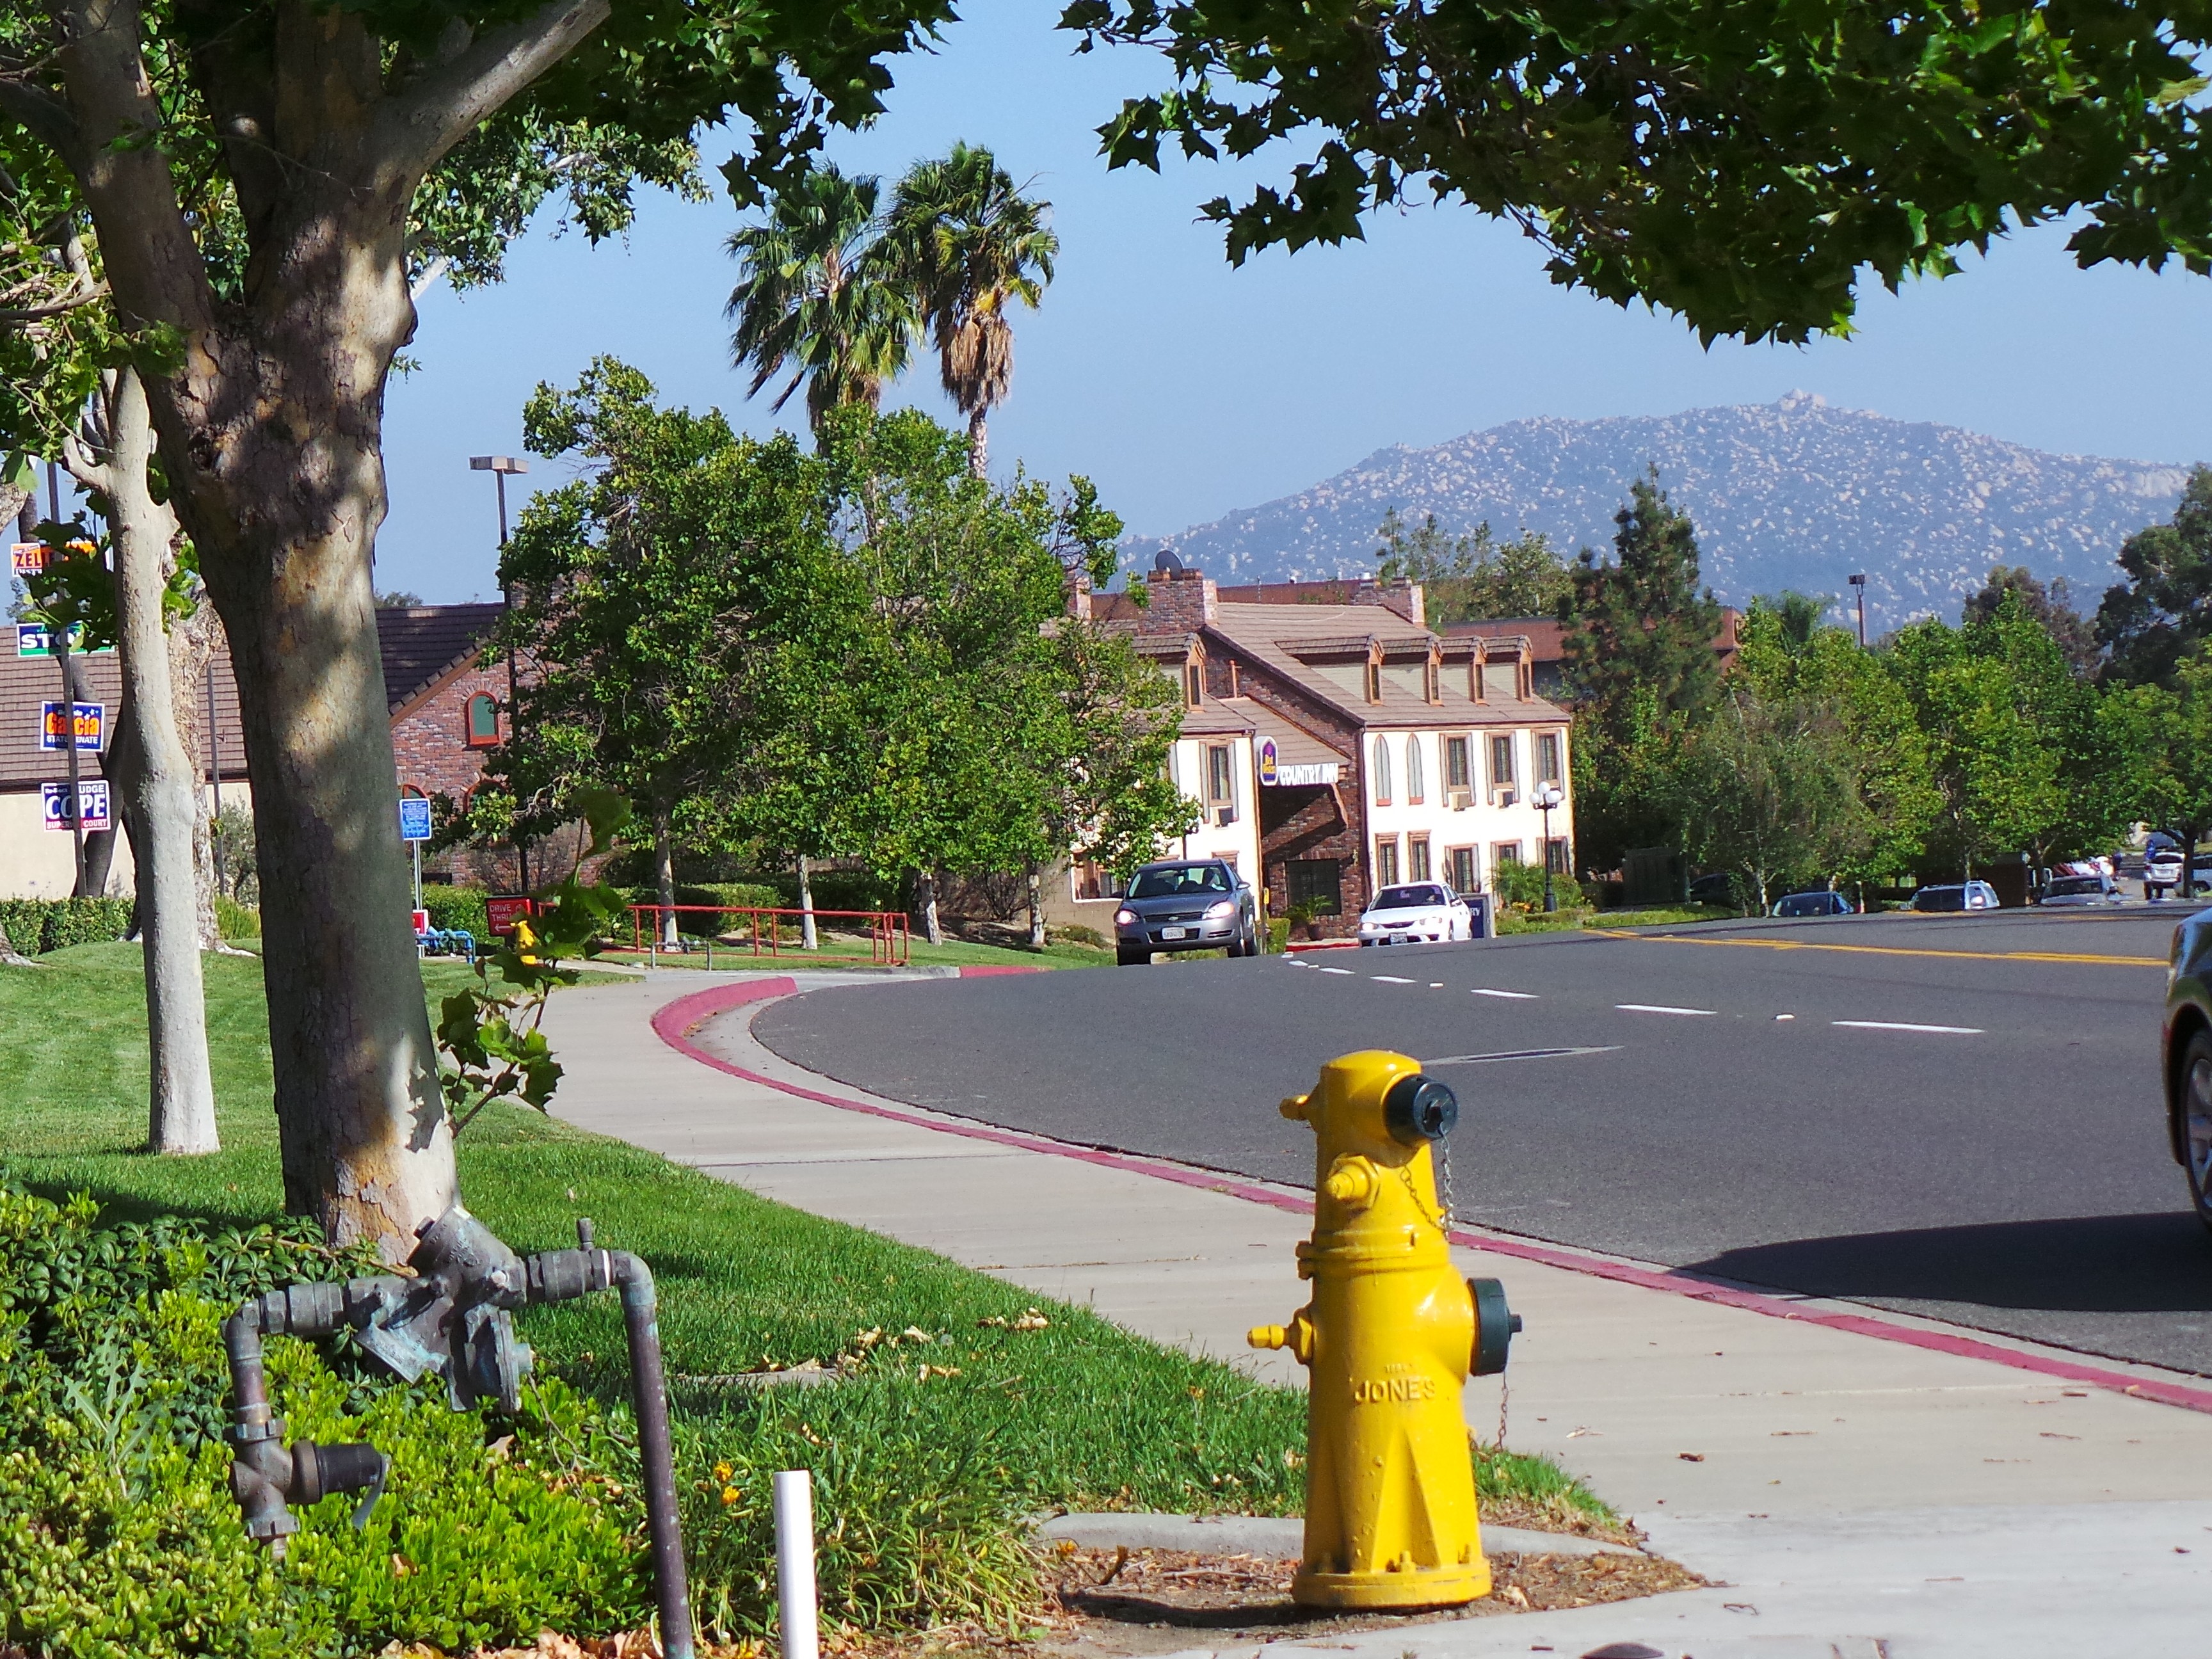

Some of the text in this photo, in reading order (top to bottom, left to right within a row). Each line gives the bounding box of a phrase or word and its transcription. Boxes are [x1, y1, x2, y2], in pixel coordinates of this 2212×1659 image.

[46, 712, 100, 735] Gacia
[75, 736, 99, 745] ENATE
[1279, 762, 1338, 786] COUNTRY INN
[79, 784, 105, 794] UDGE
[45, 794, 106, 819] COPE
[83, 819, 108, 828] COURT
[490, 904, 511, 912] DRIVE
[1354, 1375, 1436, 1402] JONES
